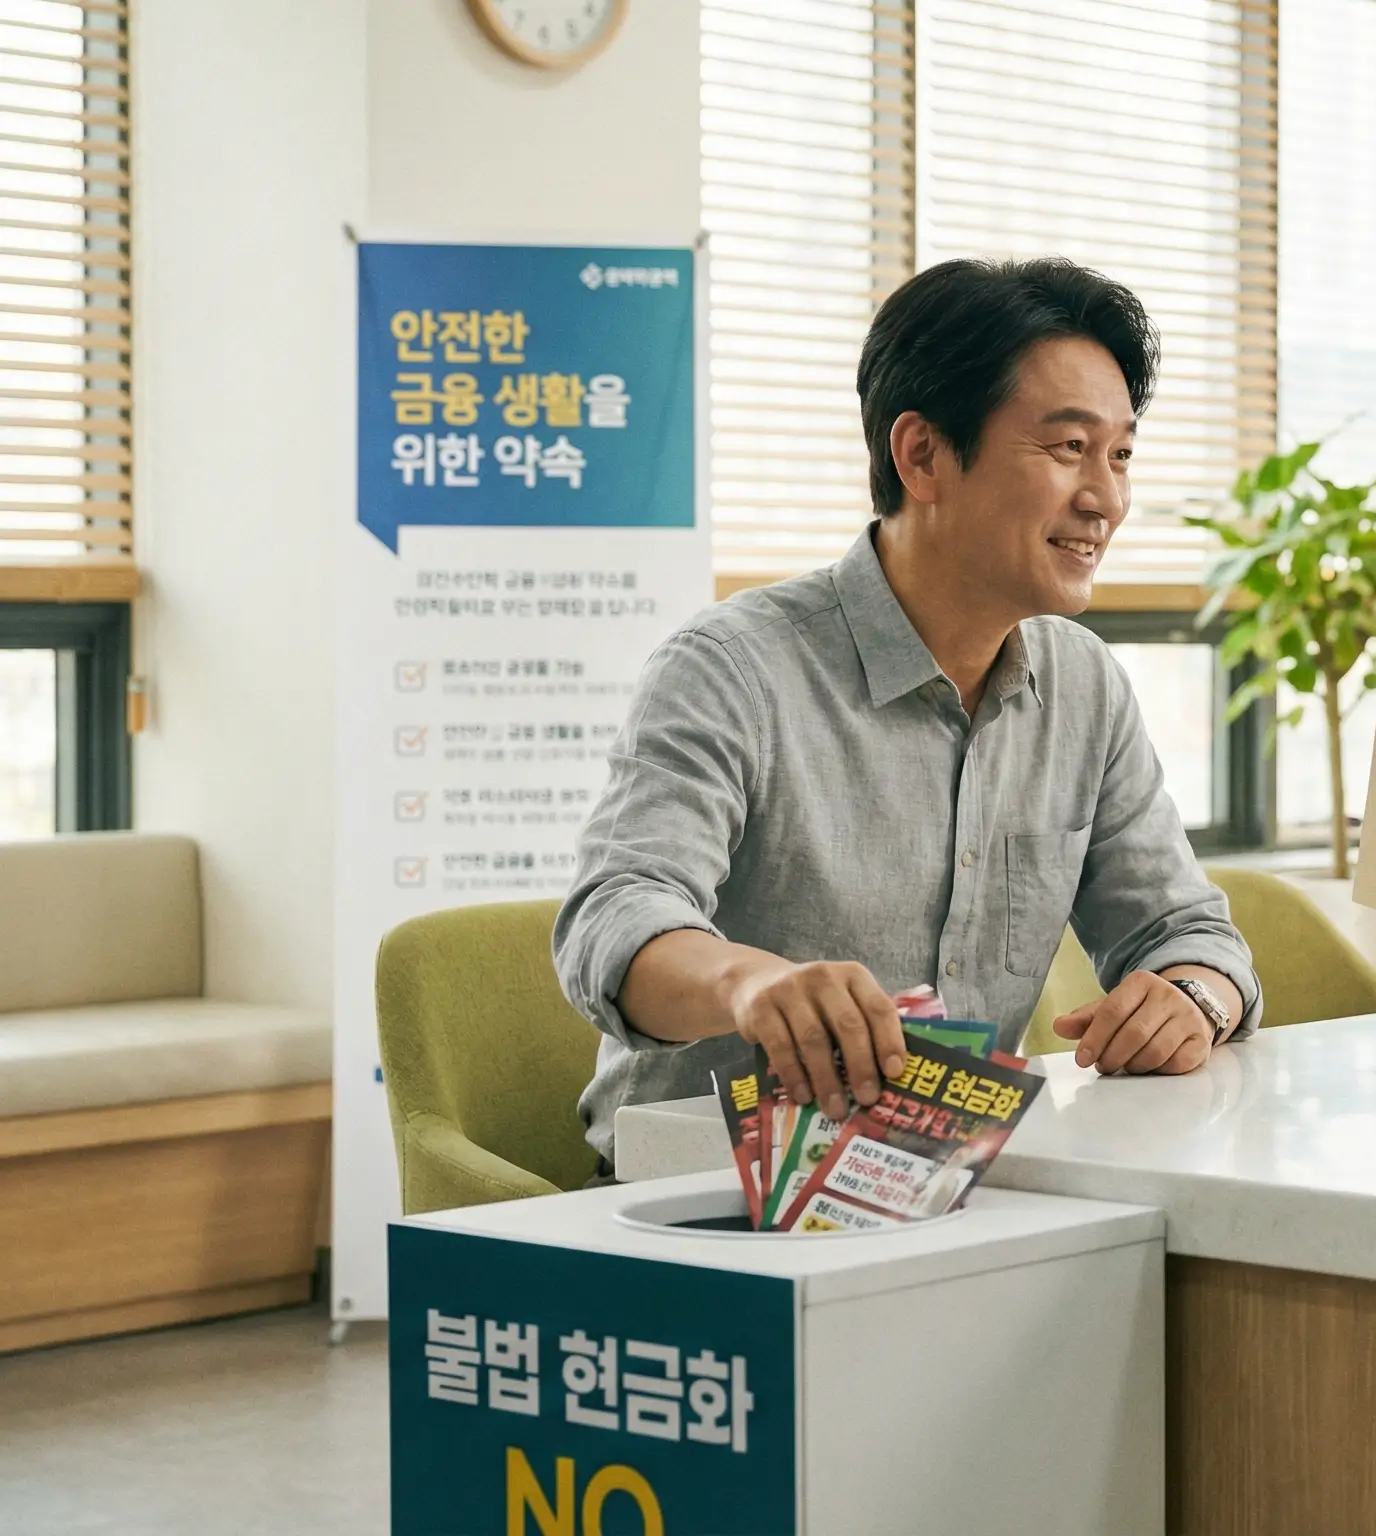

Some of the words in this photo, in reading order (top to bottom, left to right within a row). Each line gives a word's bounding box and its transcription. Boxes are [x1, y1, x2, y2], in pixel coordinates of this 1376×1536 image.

[391, 310, 530, 365] 안전한
[391, 373, 485, 426] 금융
[494, 374, 632, 429] 생활을
[391, 433, 485, 487] 위한
[494, 435, 588, 489] 약속
[941, 1069, 1025, 1121] 현금화
[425, 1309, 540, 1416] 불법
[559, 1330, 755, 1453] 현금화
[506, 1447, 664, 1536] NO
